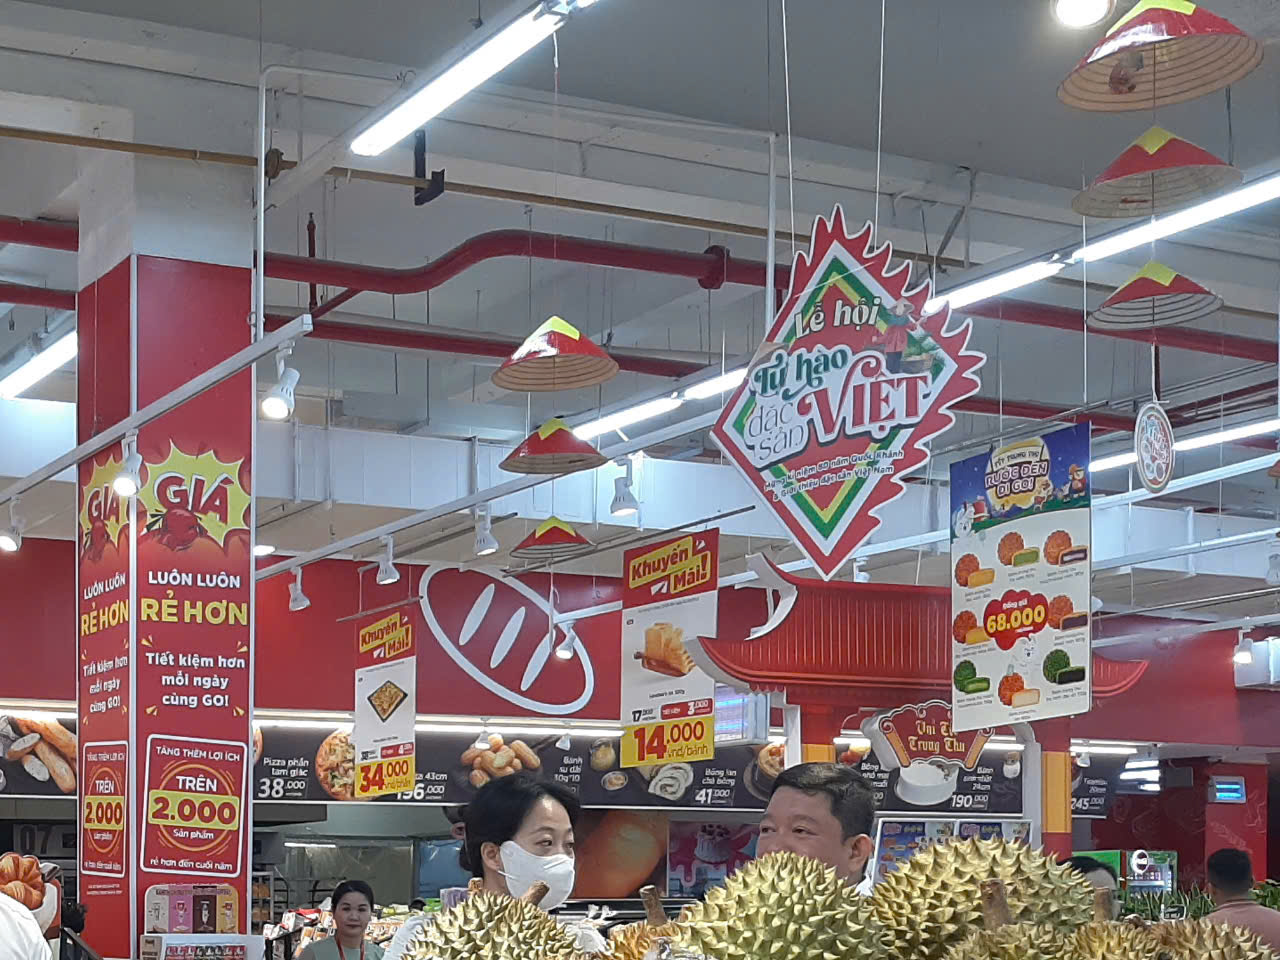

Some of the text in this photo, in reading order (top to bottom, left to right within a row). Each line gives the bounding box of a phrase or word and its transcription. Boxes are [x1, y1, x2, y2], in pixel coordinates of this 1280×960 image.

[794, 295, 881, 339] Lễ hội
[782, 347, 849, 400] hào
[796, 354, 931, 437] VIỆT
[154, 472, 234, 525] GIÁ
[631, 544, 689, 582] Khuyến
[673, 553, 708, 591] Mãi!
[148, 569, 241, 588] LUÔN LUÔN
[99, 599, 129, 631] HƠN
[140, 589, 248, 626] RẺ HƠN
[986, 604, 1046, 634] 68.000
[145, 651, 245, 669] Tiết kiệm hơn
[161, 670, 229, 690] mỗi ngày
[162, 692, 229, 708] cùng GO!
[633, 720, 705, 762] 14.000
[908, 735, 965, 753] Trung Thu
[182, 746, 208, 759] THÊM
[208, 749, 223, 760] LỢI
[224, 749, 241, 762] ÍCH
[263, 756, 286, 767] Pizza
[95, 777, 115, 794] TRÊN
[176, 774, 218, 792] TRÊN
[359, 759, 410, 793] 34.000
[257, 777, 306, 798] 38.000
[695, 788, 731, 805] 41.000
[151, 796, 237, 825] 2.000
[951, 794, 989, 808] 190.000
[1071, 796, 1105, 810] 245.000
[85, 801, 123, 825] 2.000
[173, 828, 190, 839] Sản
